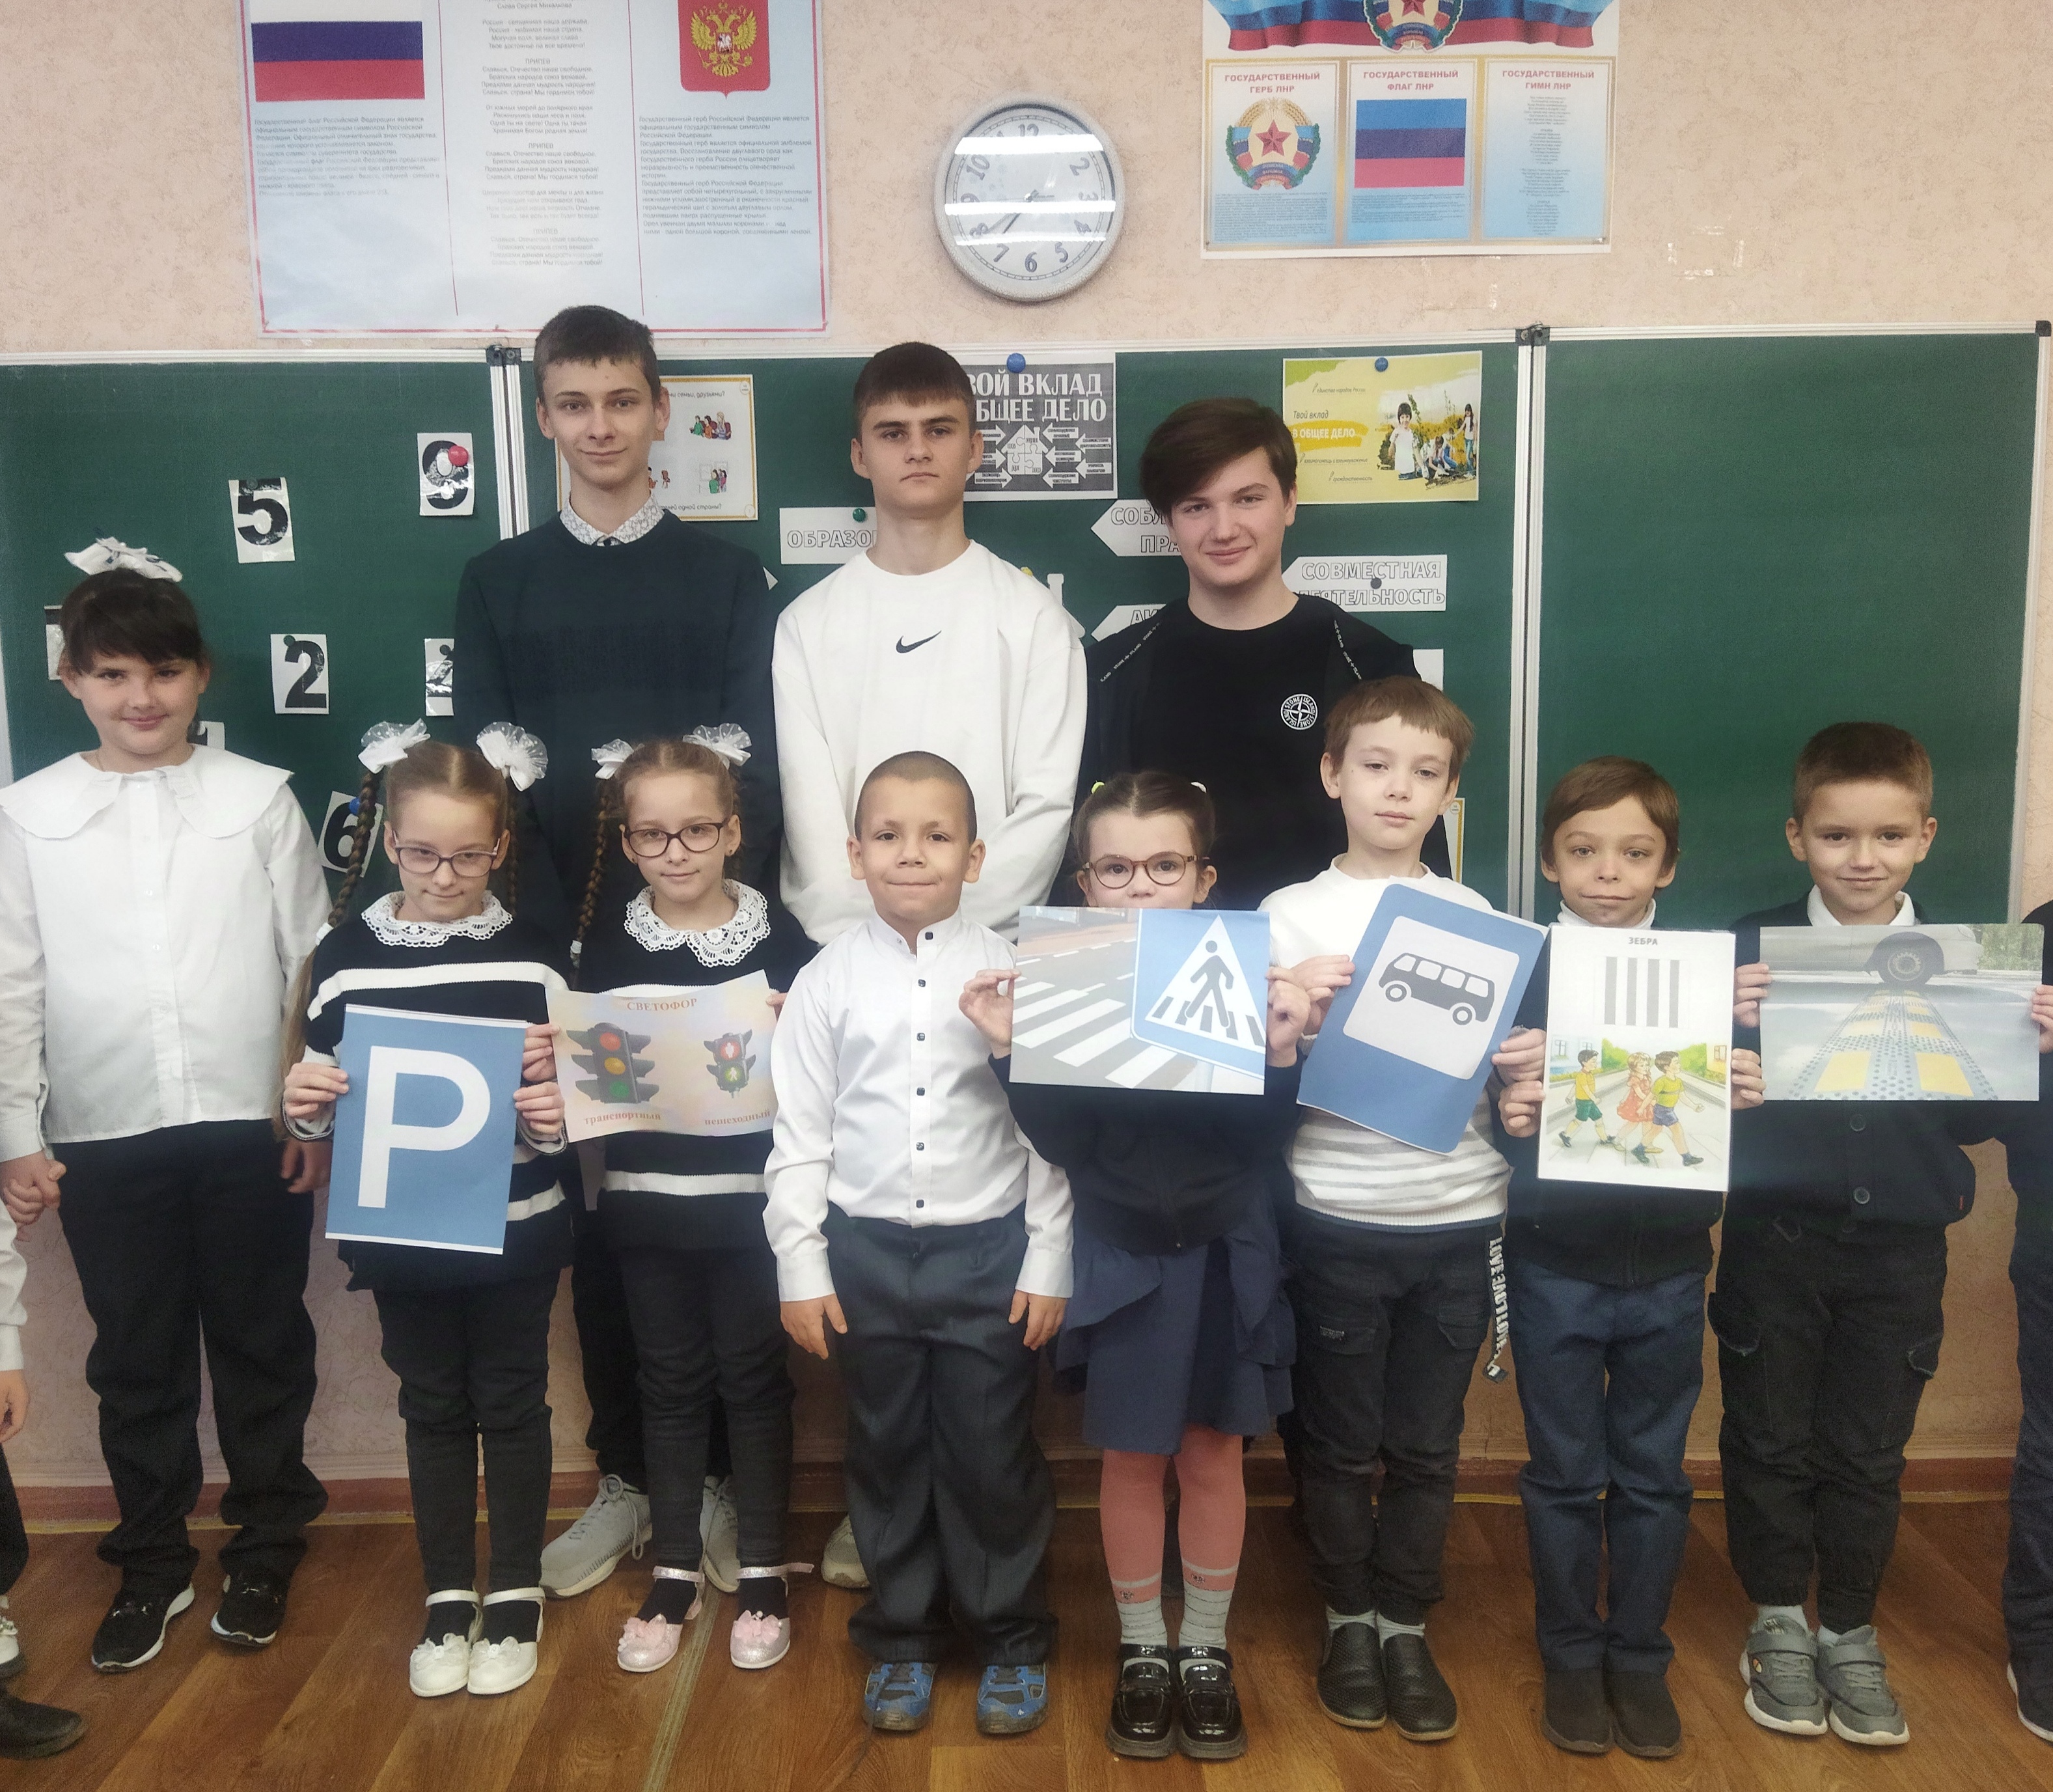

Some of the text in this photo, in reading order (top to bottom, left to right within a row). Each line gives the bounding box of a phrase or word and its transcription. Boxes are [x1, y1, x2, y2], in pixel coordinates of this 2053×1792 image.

[1224, 71, 1320, 83] ГОСУДАРСТВЕННЫЙ
[1364, 70, 1459, 79] ГОСУДАРСТВЕННЫЙ
[1502, 70, 1595, 79] ГОСУДАРСТВЕННЫЙ
[1387, 83, 1412, 91] ФЛАГ
[967, 154, 991, 180] 10
[1069, 157, 1090, 176] 2
[969, 223, 989, 238] 8
[1074, 220, 1092, 234] 4
[993, 243, 1010, 262] 7
[1054, 241, 1069, 263] 5
[1025, 251, 1038, 273] 6
[967, 369, 1103, 397] ВОЙ ВКЛАД
[976, 398, 1107, 424] БЩЕЕ ДЕЛО
[1293, 409, 1329, 419] Твой вклад
[1299, 428, 1329, 440] ОБЩЕЕ
[1331, 428, 1355, 439] ДЕЛО
[421, 441, 469, 510] 9
[238, 478, 288, 545] 5
[1110, 506, 1166, 526] СОБЛ
[1140, 534, 1181, 553] ПРА
[1301, 560, 1442, 580] СОВМЕСТНАЯ
[1131, 609, 1161, 626] АК
[284, 641, 327, 709] 2
[1284, 696, 1301, 710] STONE
[324, 802, 372, 870] 6
[1627, 936, 1658, 946] ЗЕБРА
[627, 998, 698, 1012] СВЕТОФОР
[357, 1045, 491, 1209] P
[584, 1110, 661, 1126] транспортный
[704, 1109, 771, 1126] пешеходный
